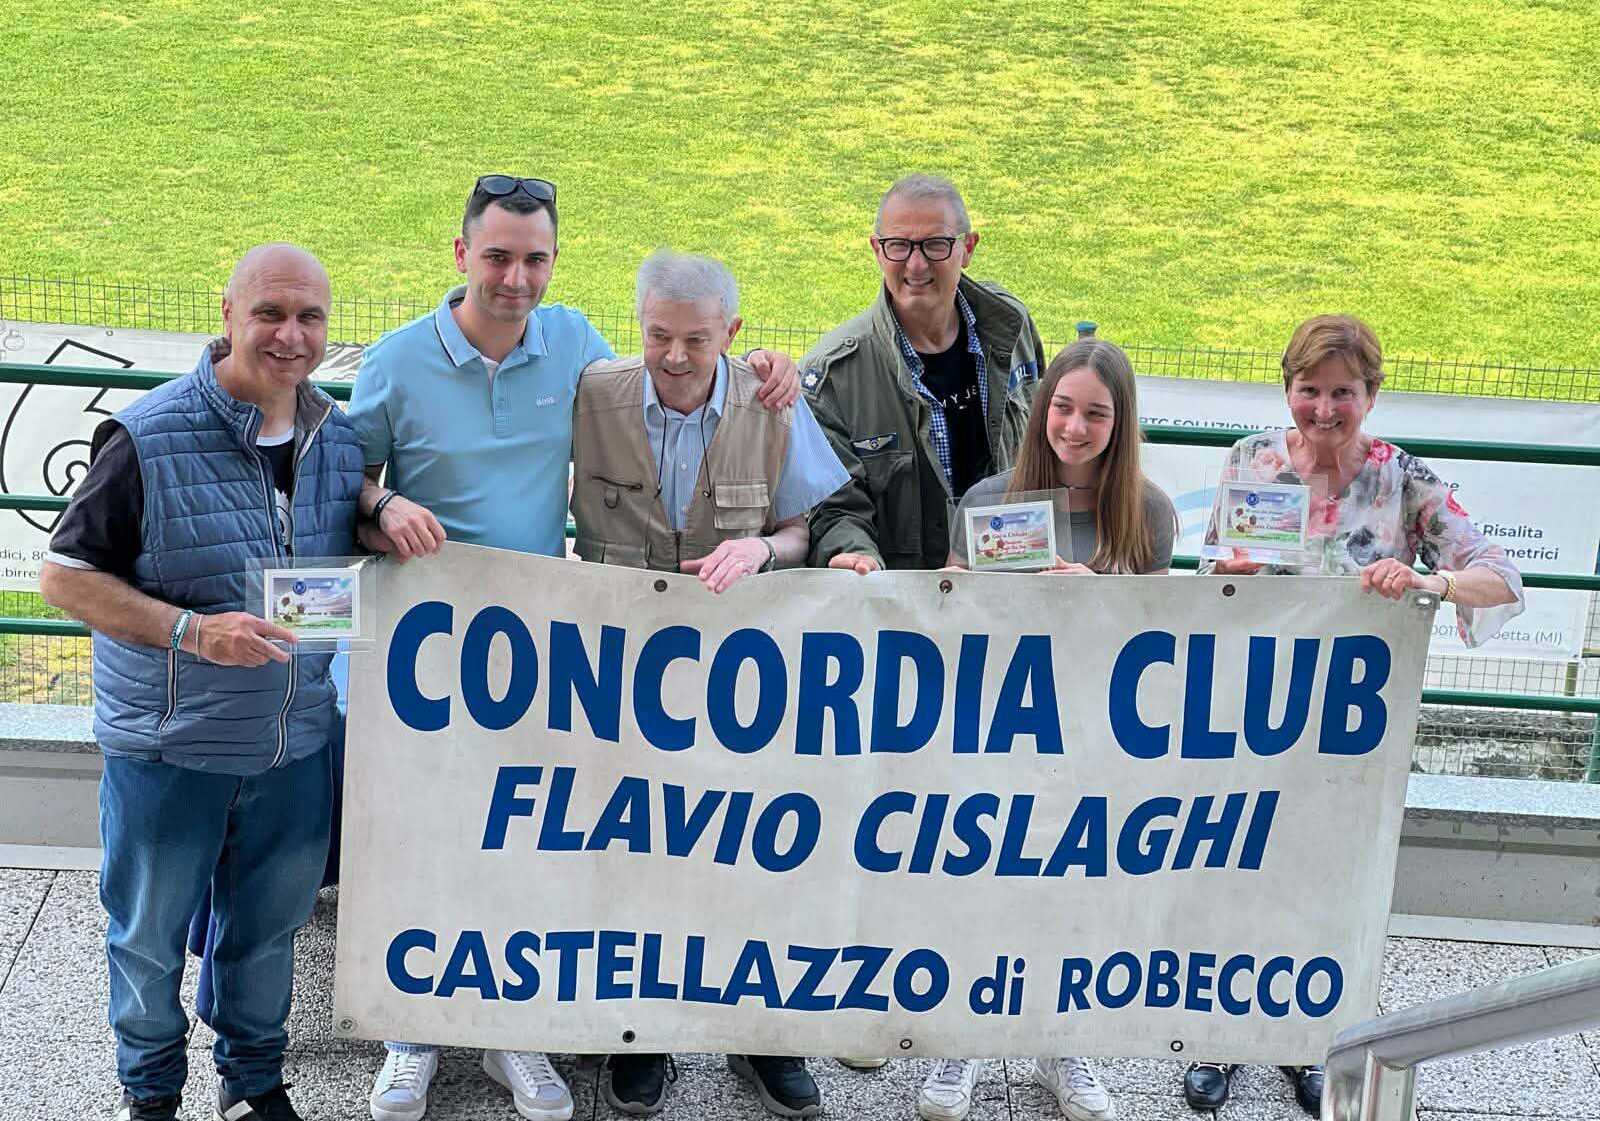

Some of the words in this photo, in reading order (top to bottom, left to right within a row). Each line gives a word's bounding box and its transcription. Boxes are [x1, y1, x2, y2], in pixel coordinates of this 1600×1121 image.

[1483, 524, 1543, 539] Risalita
[1, 567, 40, 579] .birre
[1535, 630, 1562, 645] (MI)
[388, 602, 1063, 755] CONCORDIA
[1109, 632, 1389, 758] CLUB
[483, 767, 819, 871] FLAVIO
[854, 792, 1278, 876] CISLAGHI
[388, 930, 948, 1011] CASTELLAZZO
[971, 957, 1023, 1014] di
[1058, 952, 1342, 1017] ROBECCO
